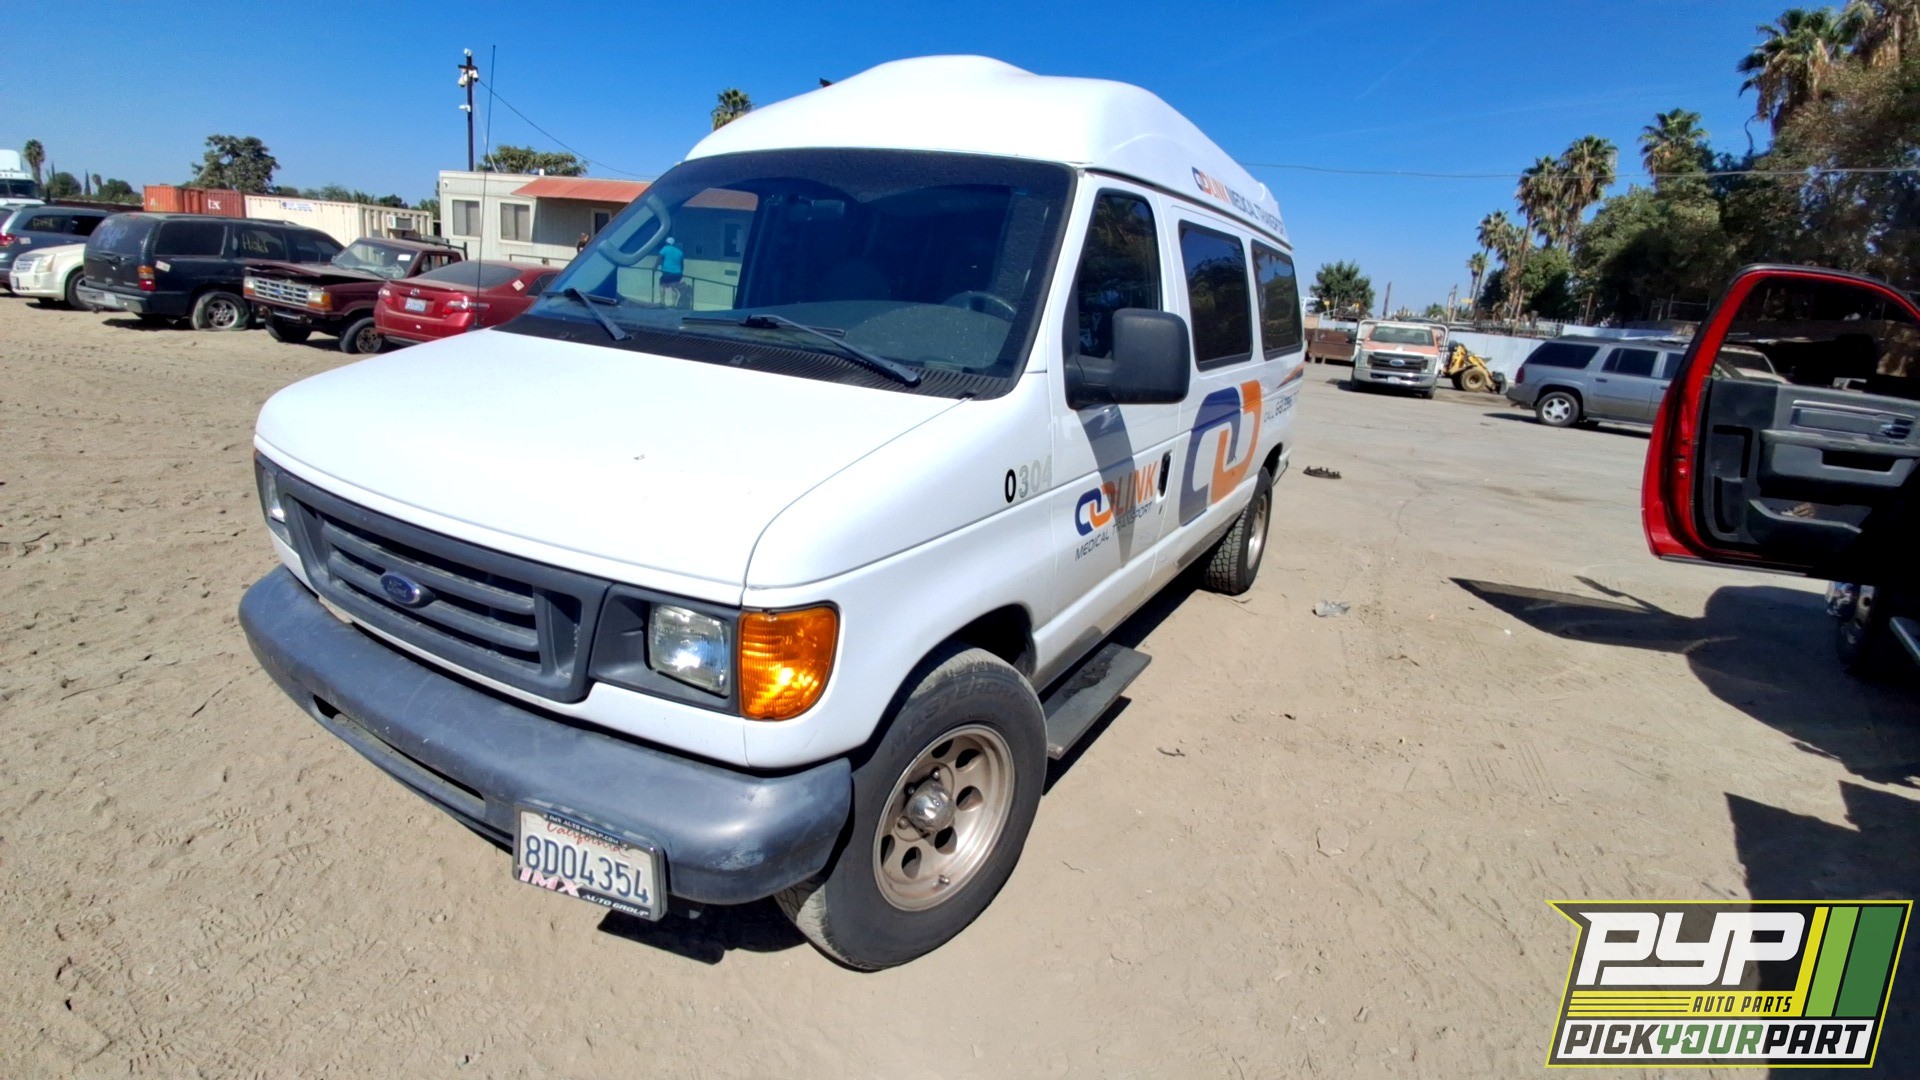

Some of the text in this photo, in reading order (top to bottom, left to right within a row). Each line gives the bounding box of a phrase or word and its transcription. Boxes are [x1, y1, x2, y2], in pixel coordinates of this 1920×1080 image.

[1004, 455, 1052, 503] 0304
[1112, 501, 1153, 535] TRANSPORT
[1075, 529, 1109, 560] MEDICAL
[519, 866, 649, 917] IMX AUTO GROUP
[525, 834, 650, 904] 8D04354
